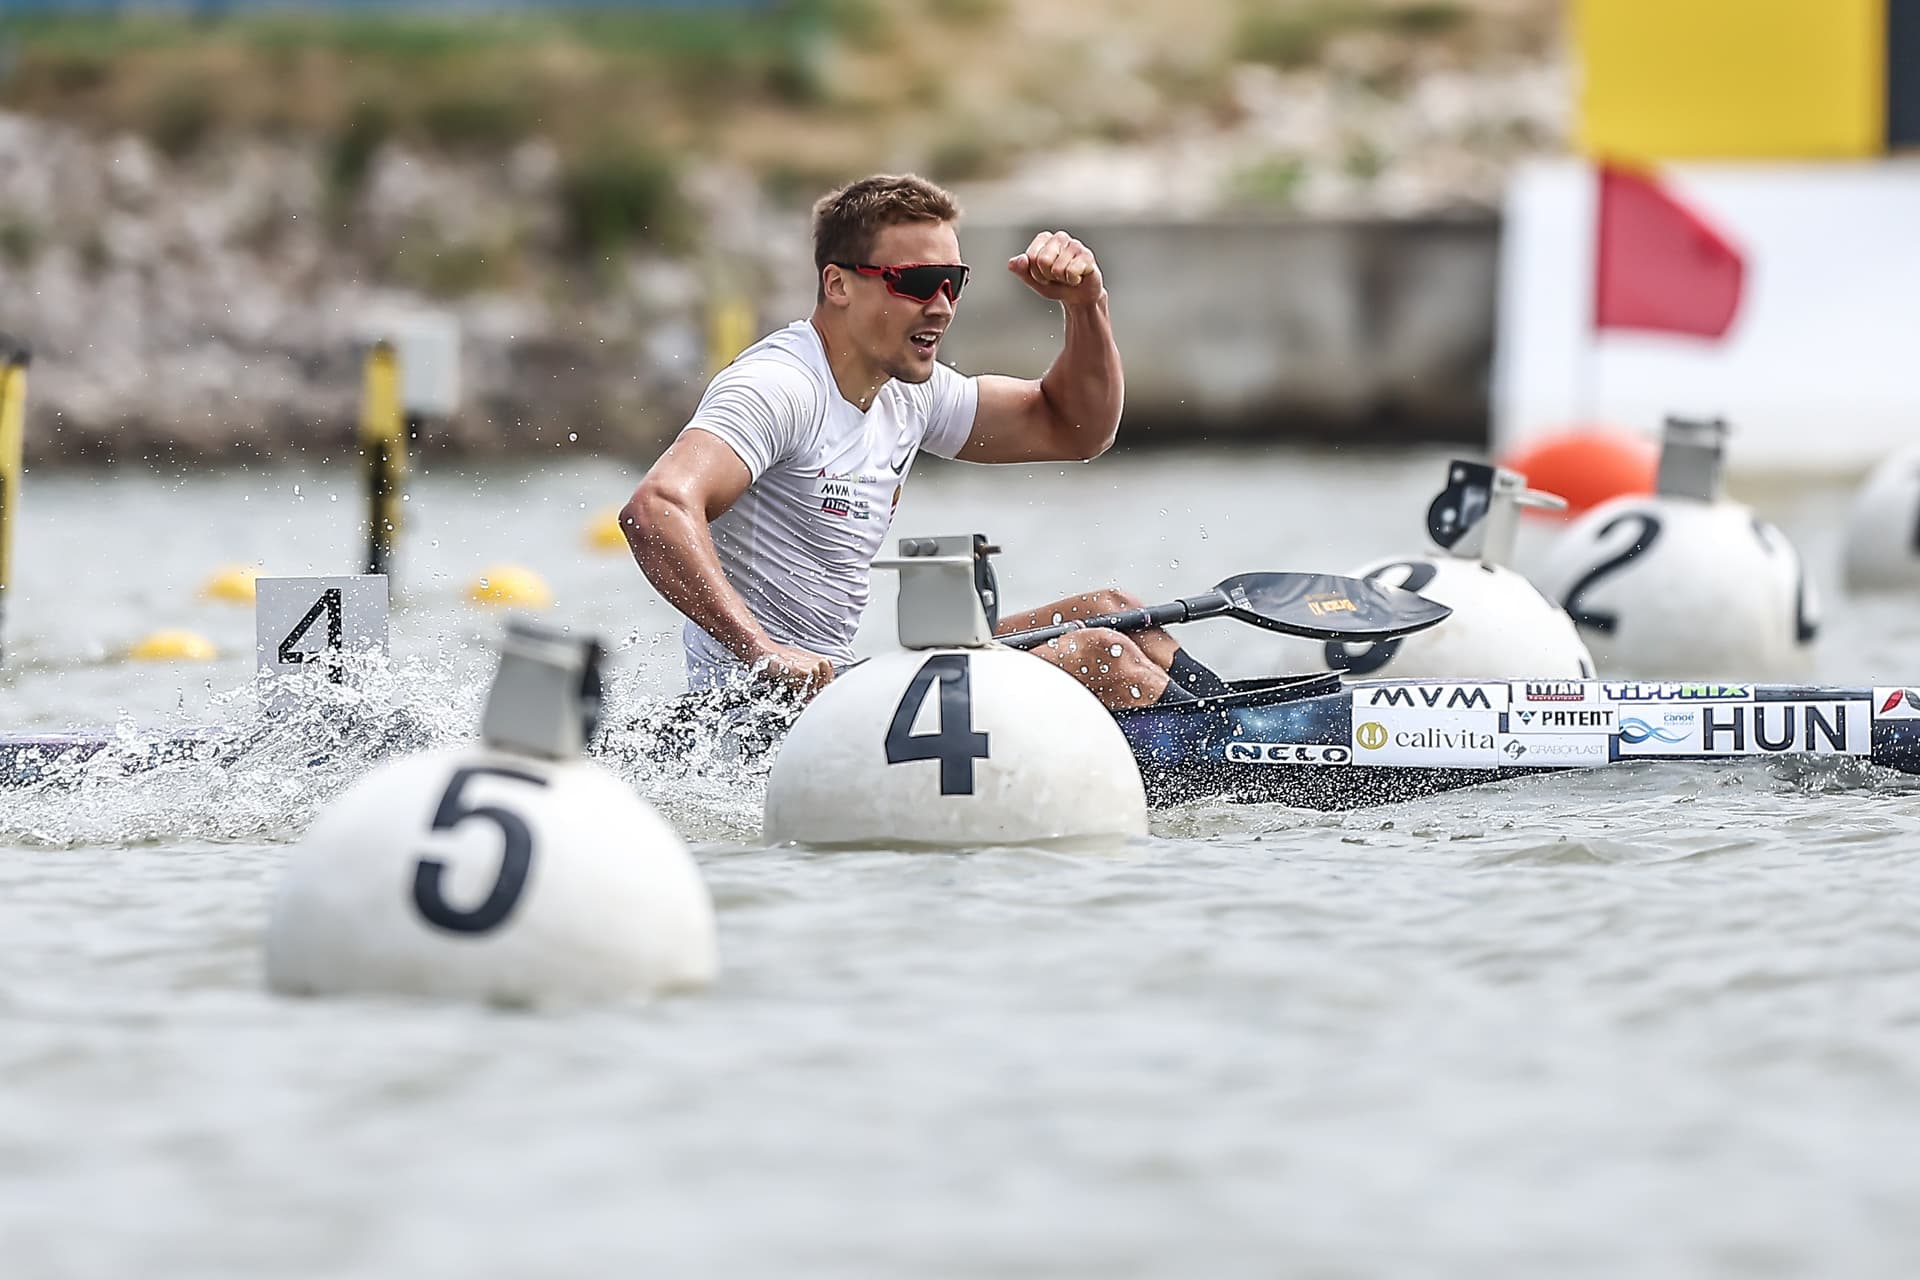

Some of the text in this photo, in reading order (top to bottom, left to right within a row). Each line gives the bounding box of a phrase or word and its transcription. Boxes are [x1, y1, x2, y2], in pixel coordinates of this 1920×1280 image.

[821, 483, 849, 497] MVM
[1564, 510, 1665, 635] 2
[278, 588, 342, 684] 4
[1370, 686, 1491, 709] MVM
[884, 653, 989, 795] 4
[1541, 710, 1614, 726] PATENT
[1663, 713, 1694, 722] canoe
[1702, 705, 1847, 752] HUN
[1394, 728, 1495, 750] calivita
[1230, 744, 1350, 762] NELO
[411, 766, 549, 936] 5
